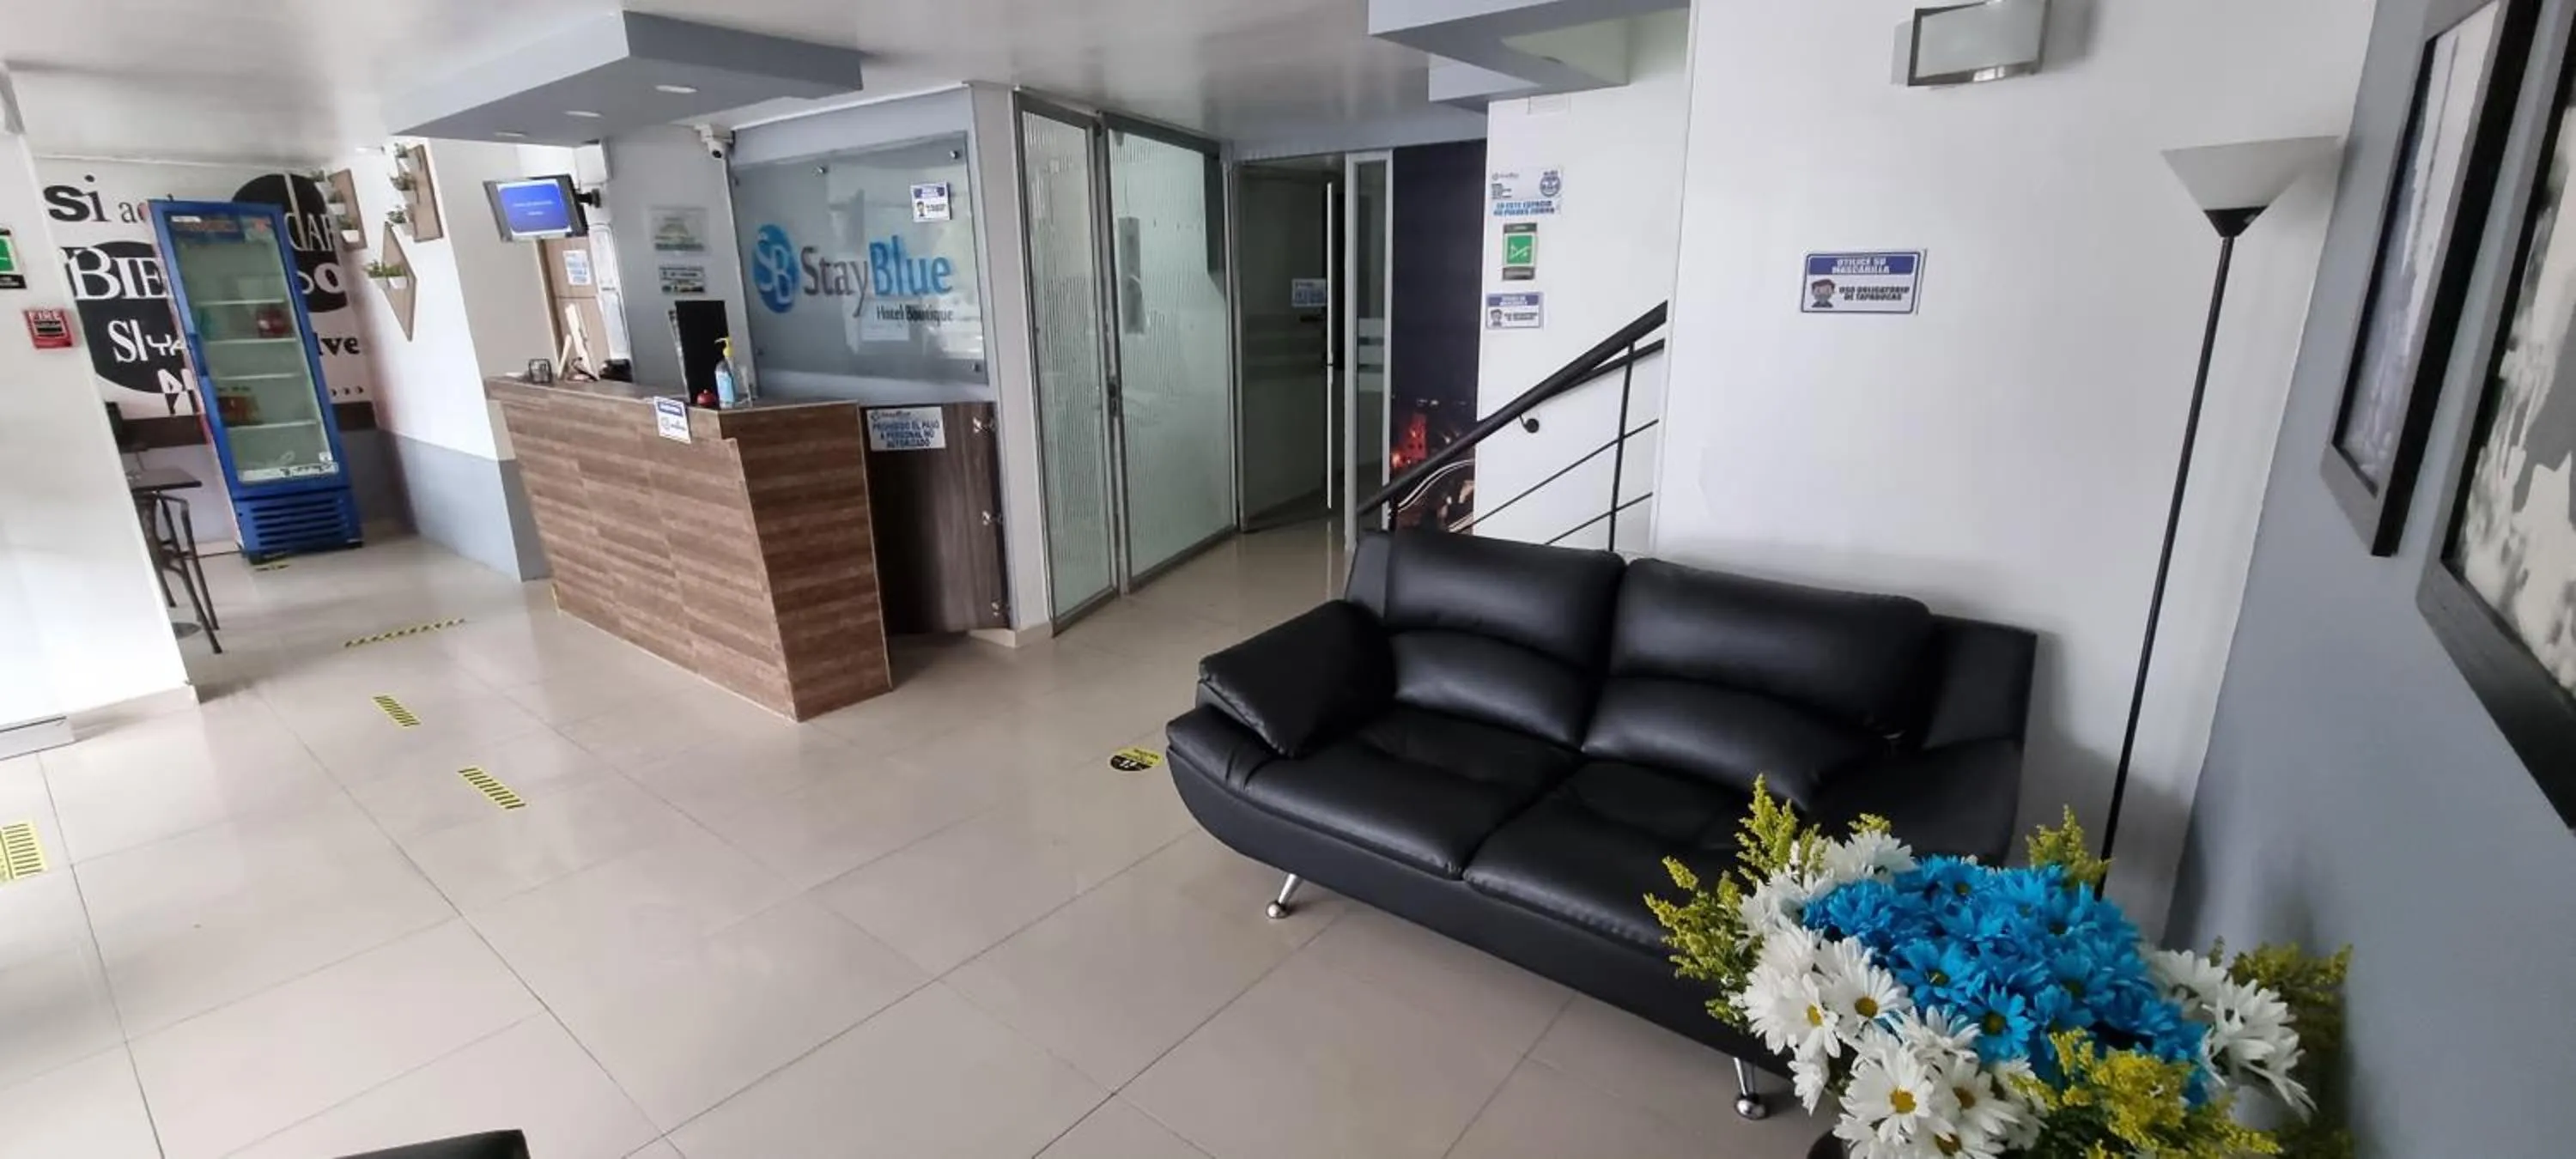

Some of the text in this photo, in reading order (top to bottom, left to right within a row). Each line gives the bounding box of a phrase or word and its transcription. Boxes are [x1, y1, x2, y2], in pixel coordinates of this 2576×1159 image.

[800, 235, 952, 318] StayBlue
[1832, 265, 1890, 274] MASCARILLA
[877, 303, 954, 324] Hotel Boutique
